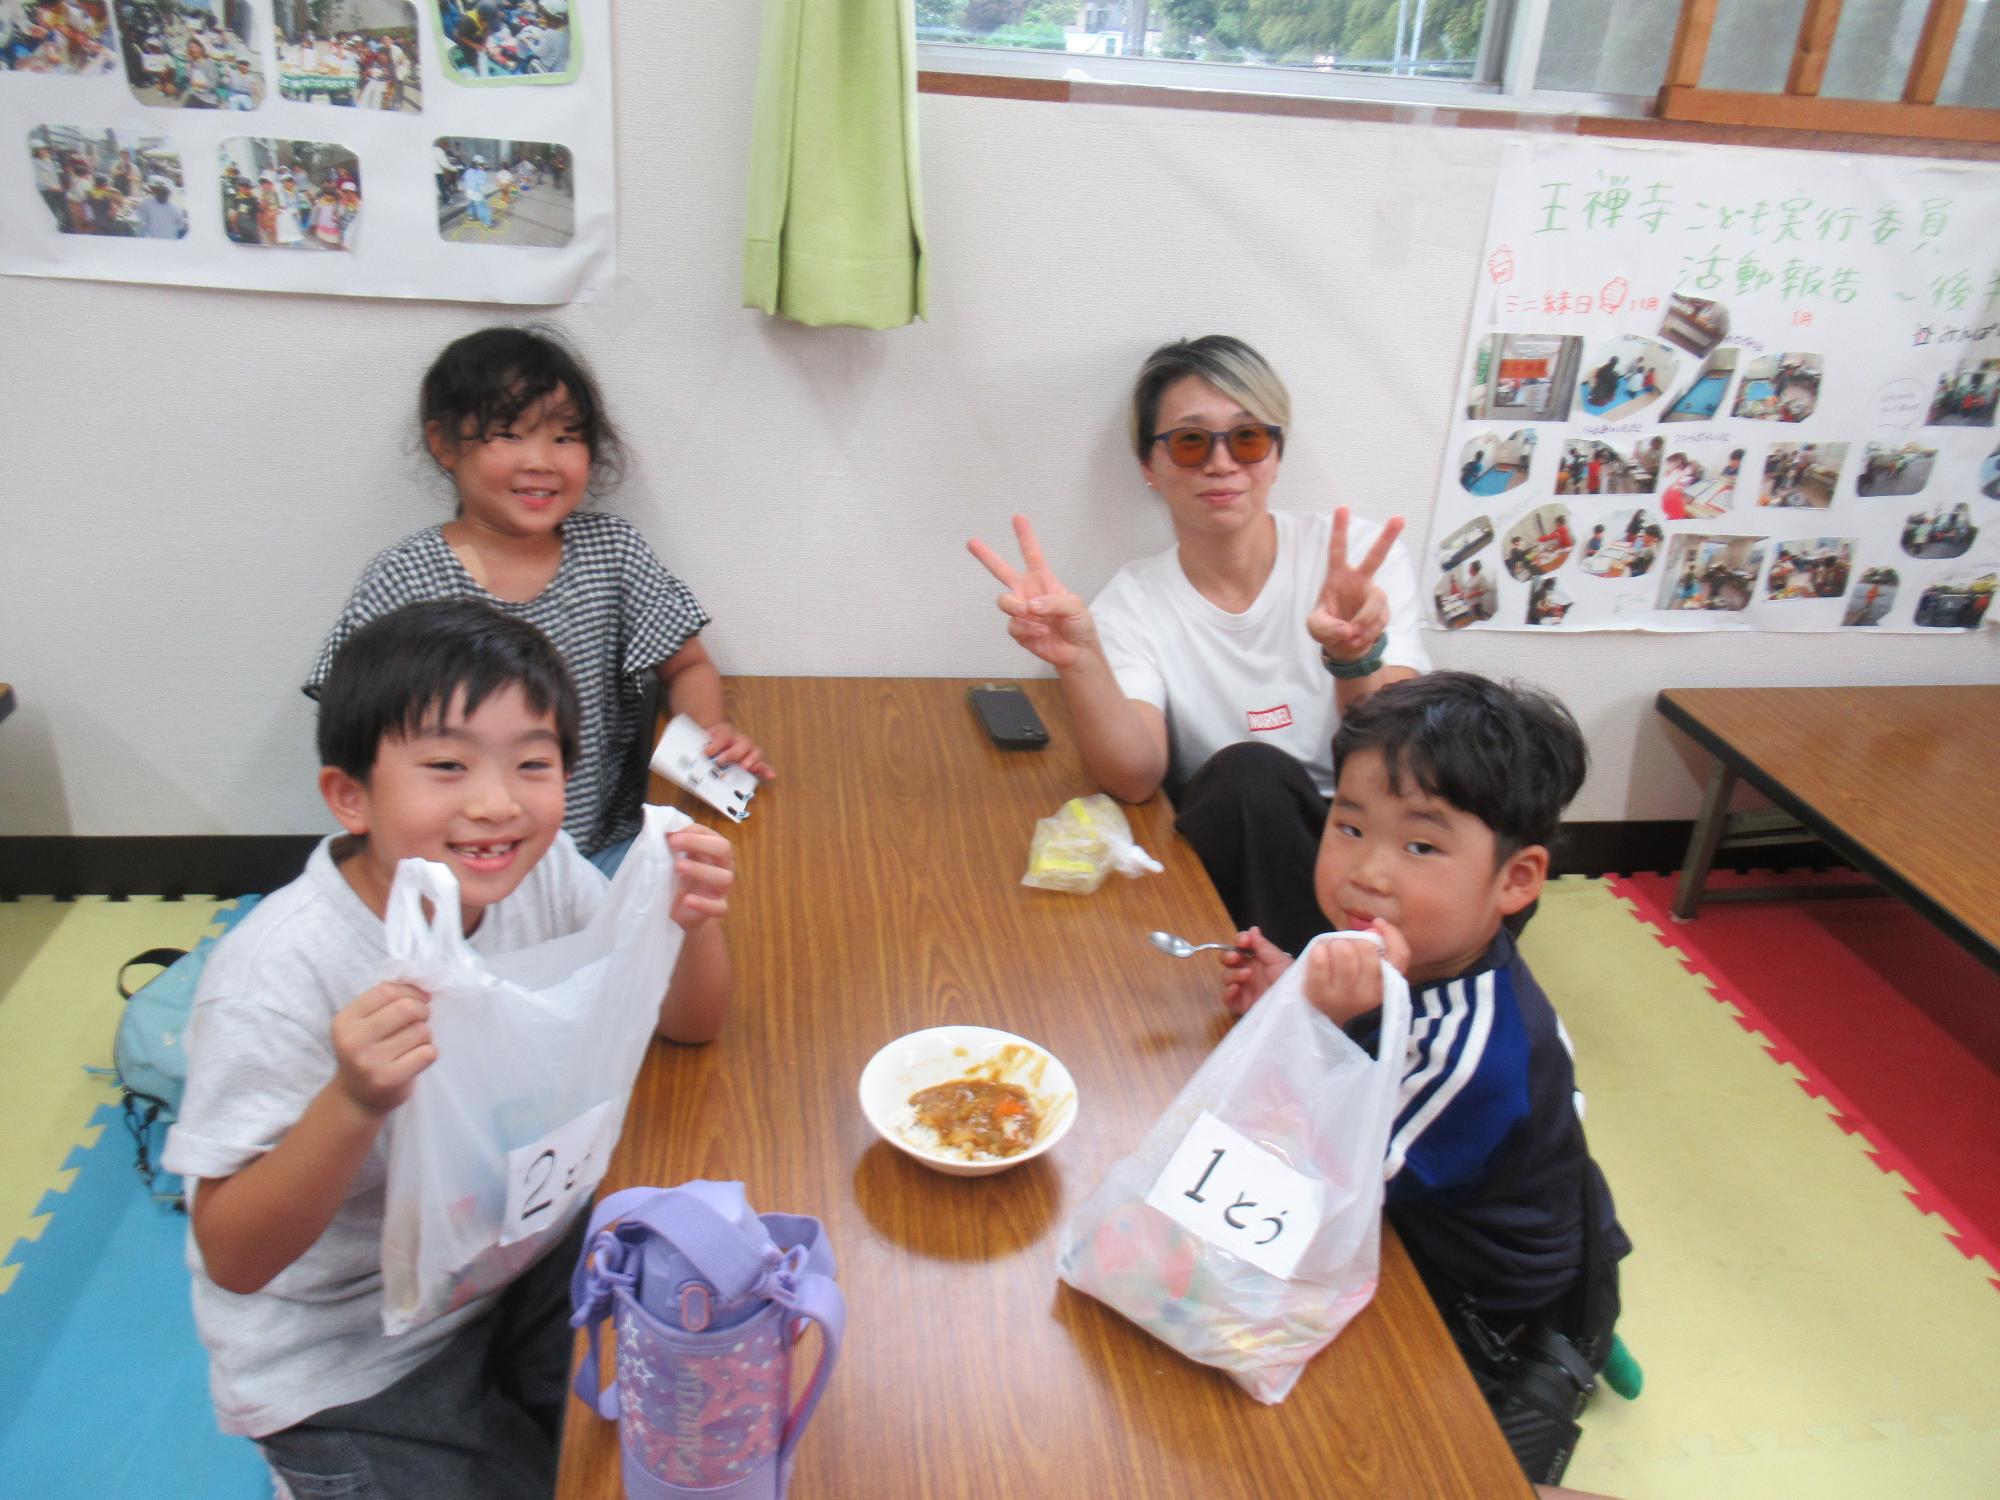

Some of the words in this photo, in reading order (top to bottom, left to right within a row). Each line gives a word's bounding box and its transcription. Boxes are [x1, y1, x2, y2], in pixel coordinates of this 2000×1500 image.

[1675, 243, 1861, 304] 活動報告
[1183, 1148, 1289, 1245] 1とう
